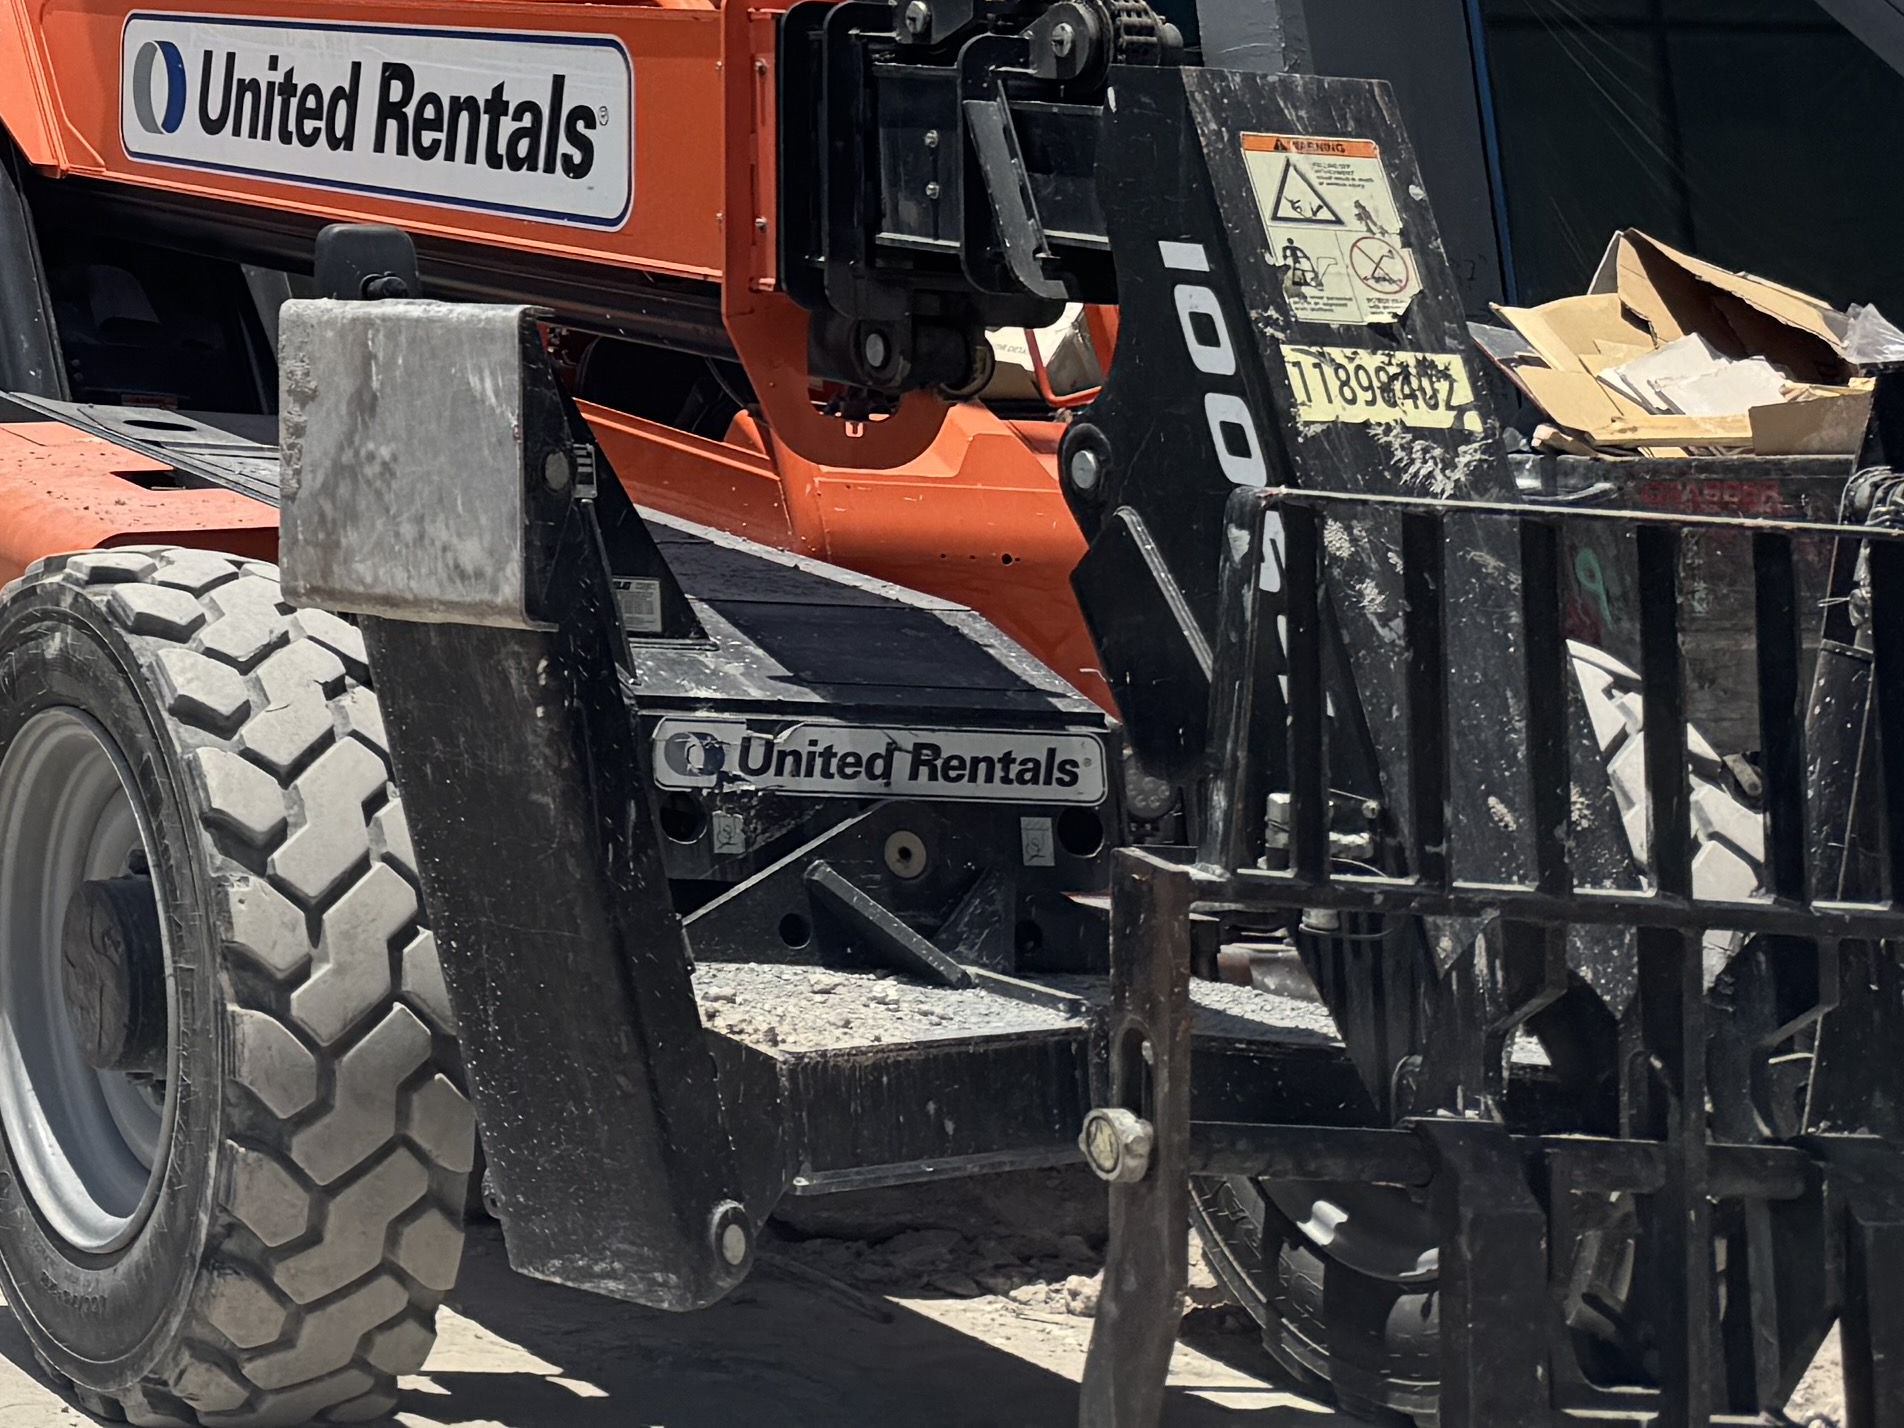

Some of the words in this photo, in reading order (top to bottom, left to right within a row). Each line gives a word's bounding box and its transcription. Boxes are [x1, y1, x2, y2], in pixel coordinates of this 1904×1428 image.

[197, 49, 362, 152] United
[374, 61, 597, 180] Rentals
[737, 735, 895, 782] United
[908, 741, 1082, 789] Rentals
